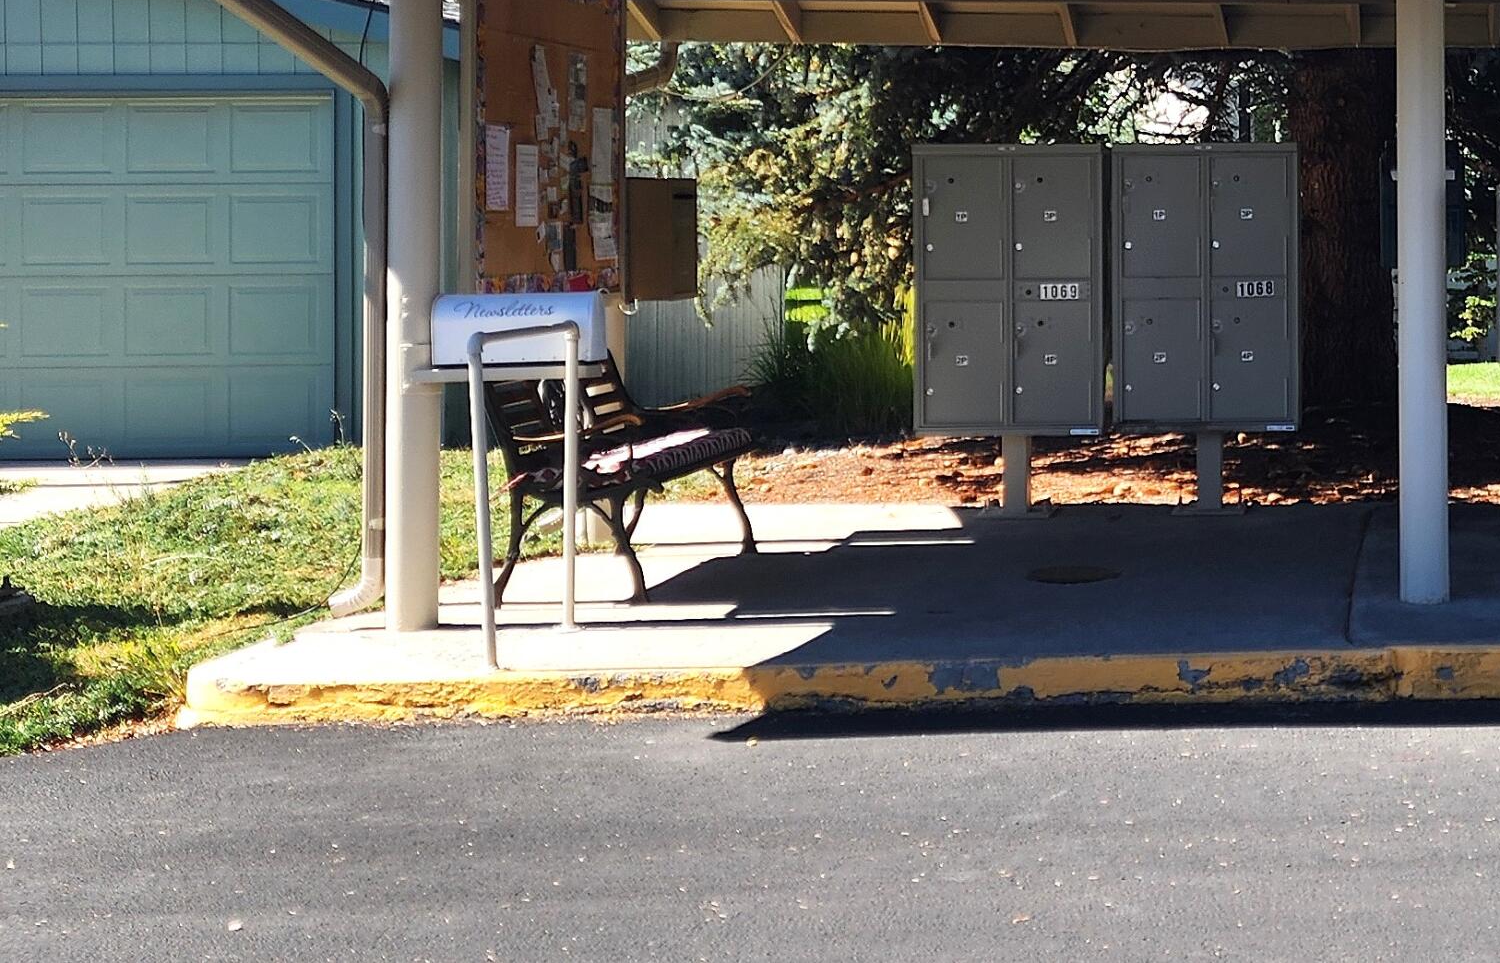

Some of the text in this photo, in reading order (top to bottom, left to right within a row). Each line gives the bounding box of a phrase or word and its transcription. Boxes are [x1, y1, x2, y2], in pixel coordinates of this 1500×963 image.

[1043, 285, 1077, 298] 1069
[1239, 281, 1273, 296] 1068
[454, 300, 555, 318] Newsletters
